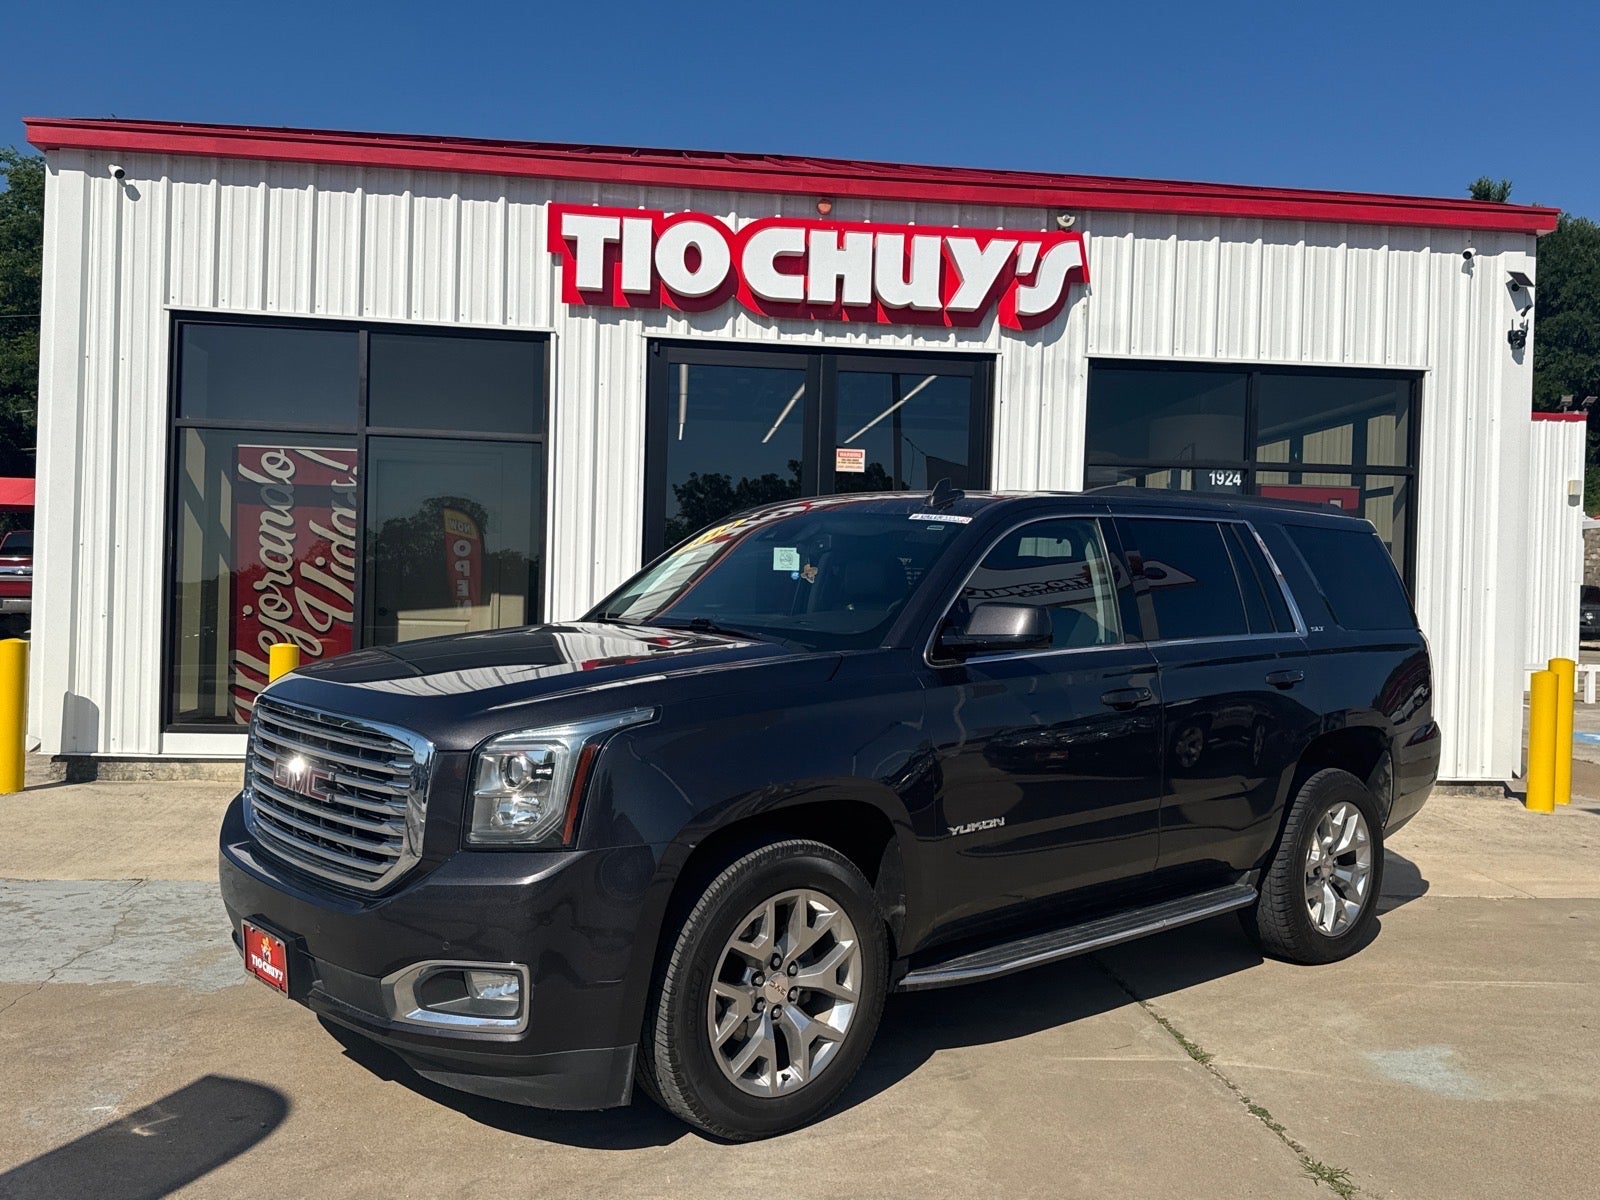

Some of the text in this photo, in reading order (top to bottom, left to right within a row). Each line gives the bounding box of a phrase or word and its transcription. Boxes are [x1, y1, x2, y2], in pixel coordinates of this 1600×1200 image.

[561, 213, 1084, 316] TIO CHUY'S
[1209, 470, 1242, 486] 1924
[273, 757, 335, 803] GMC
[947, 817, 1005, 836] YUKON
